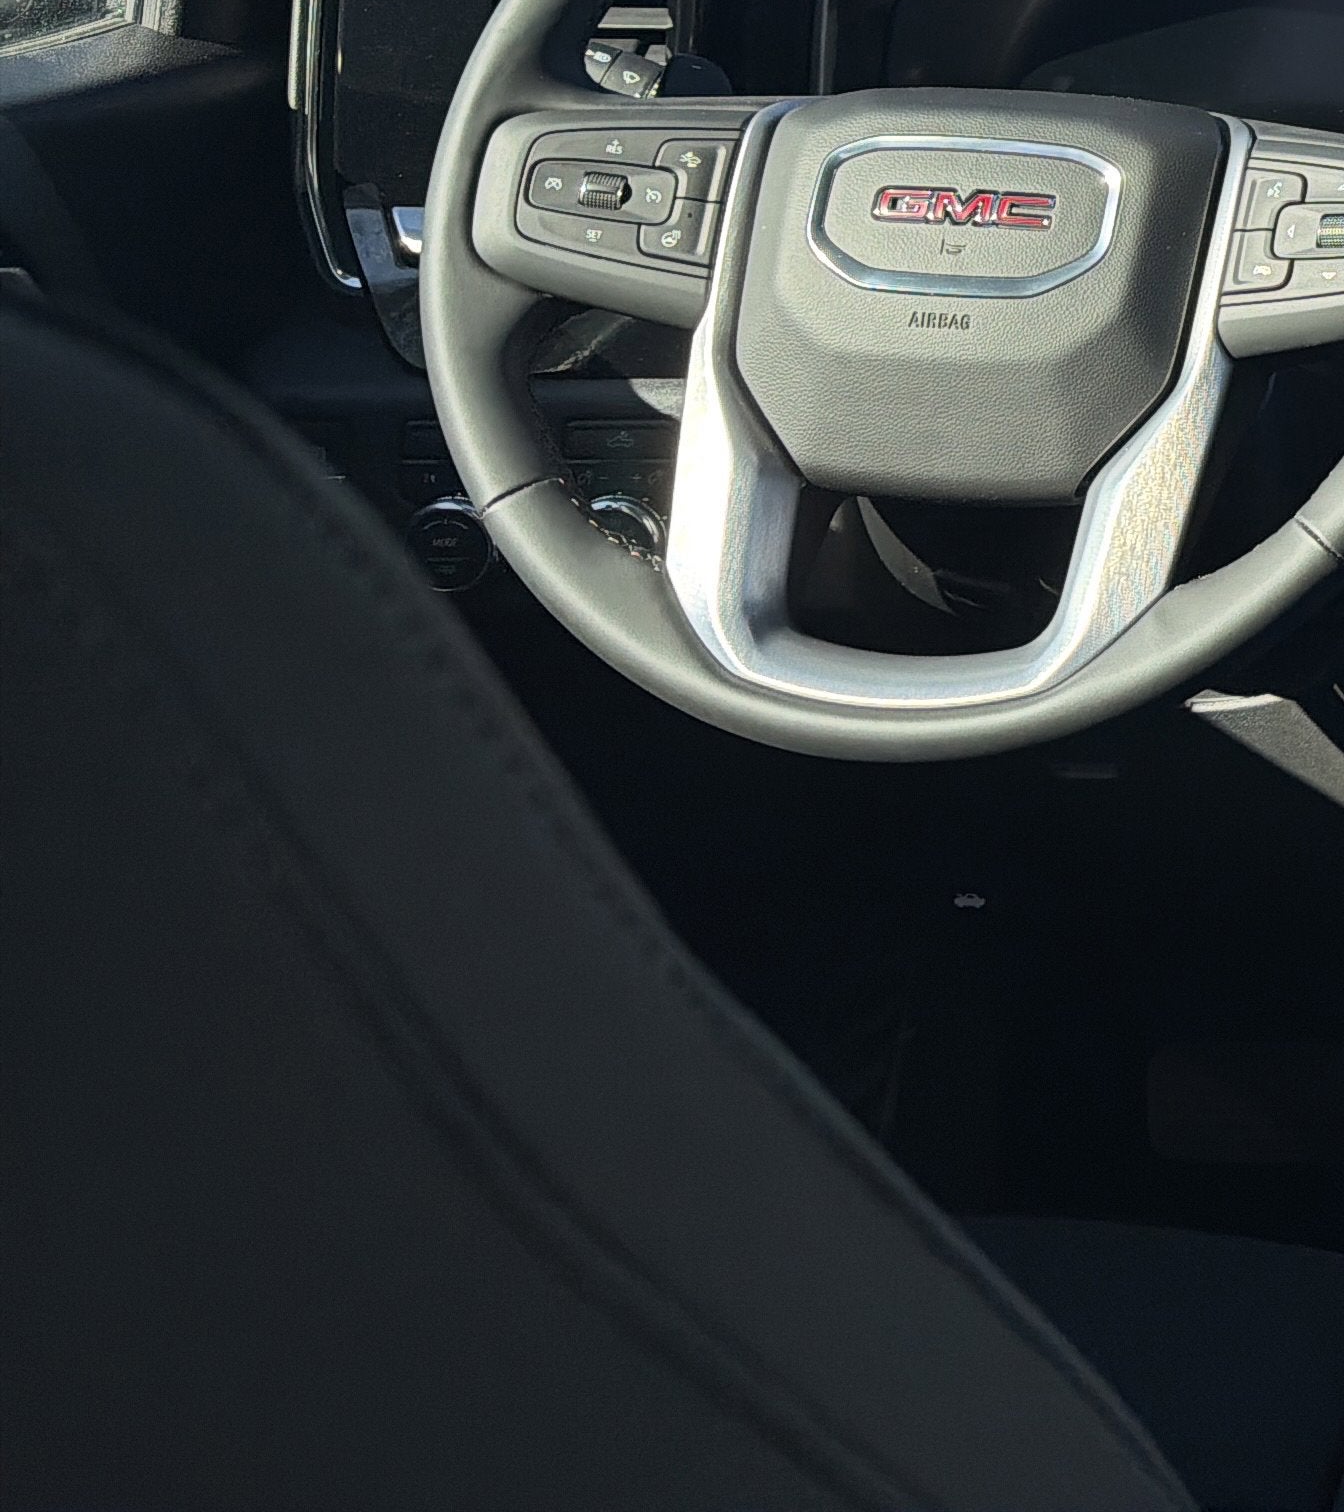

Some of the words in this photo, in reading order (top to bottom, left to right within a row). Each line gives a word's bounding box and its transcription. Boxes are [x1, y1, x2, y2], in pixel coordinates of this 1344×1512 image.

[871, 185, 1057, 230] GMC
[585, 227, 603, 240] SET
[907, 311, 971, 330] AIRBAG
